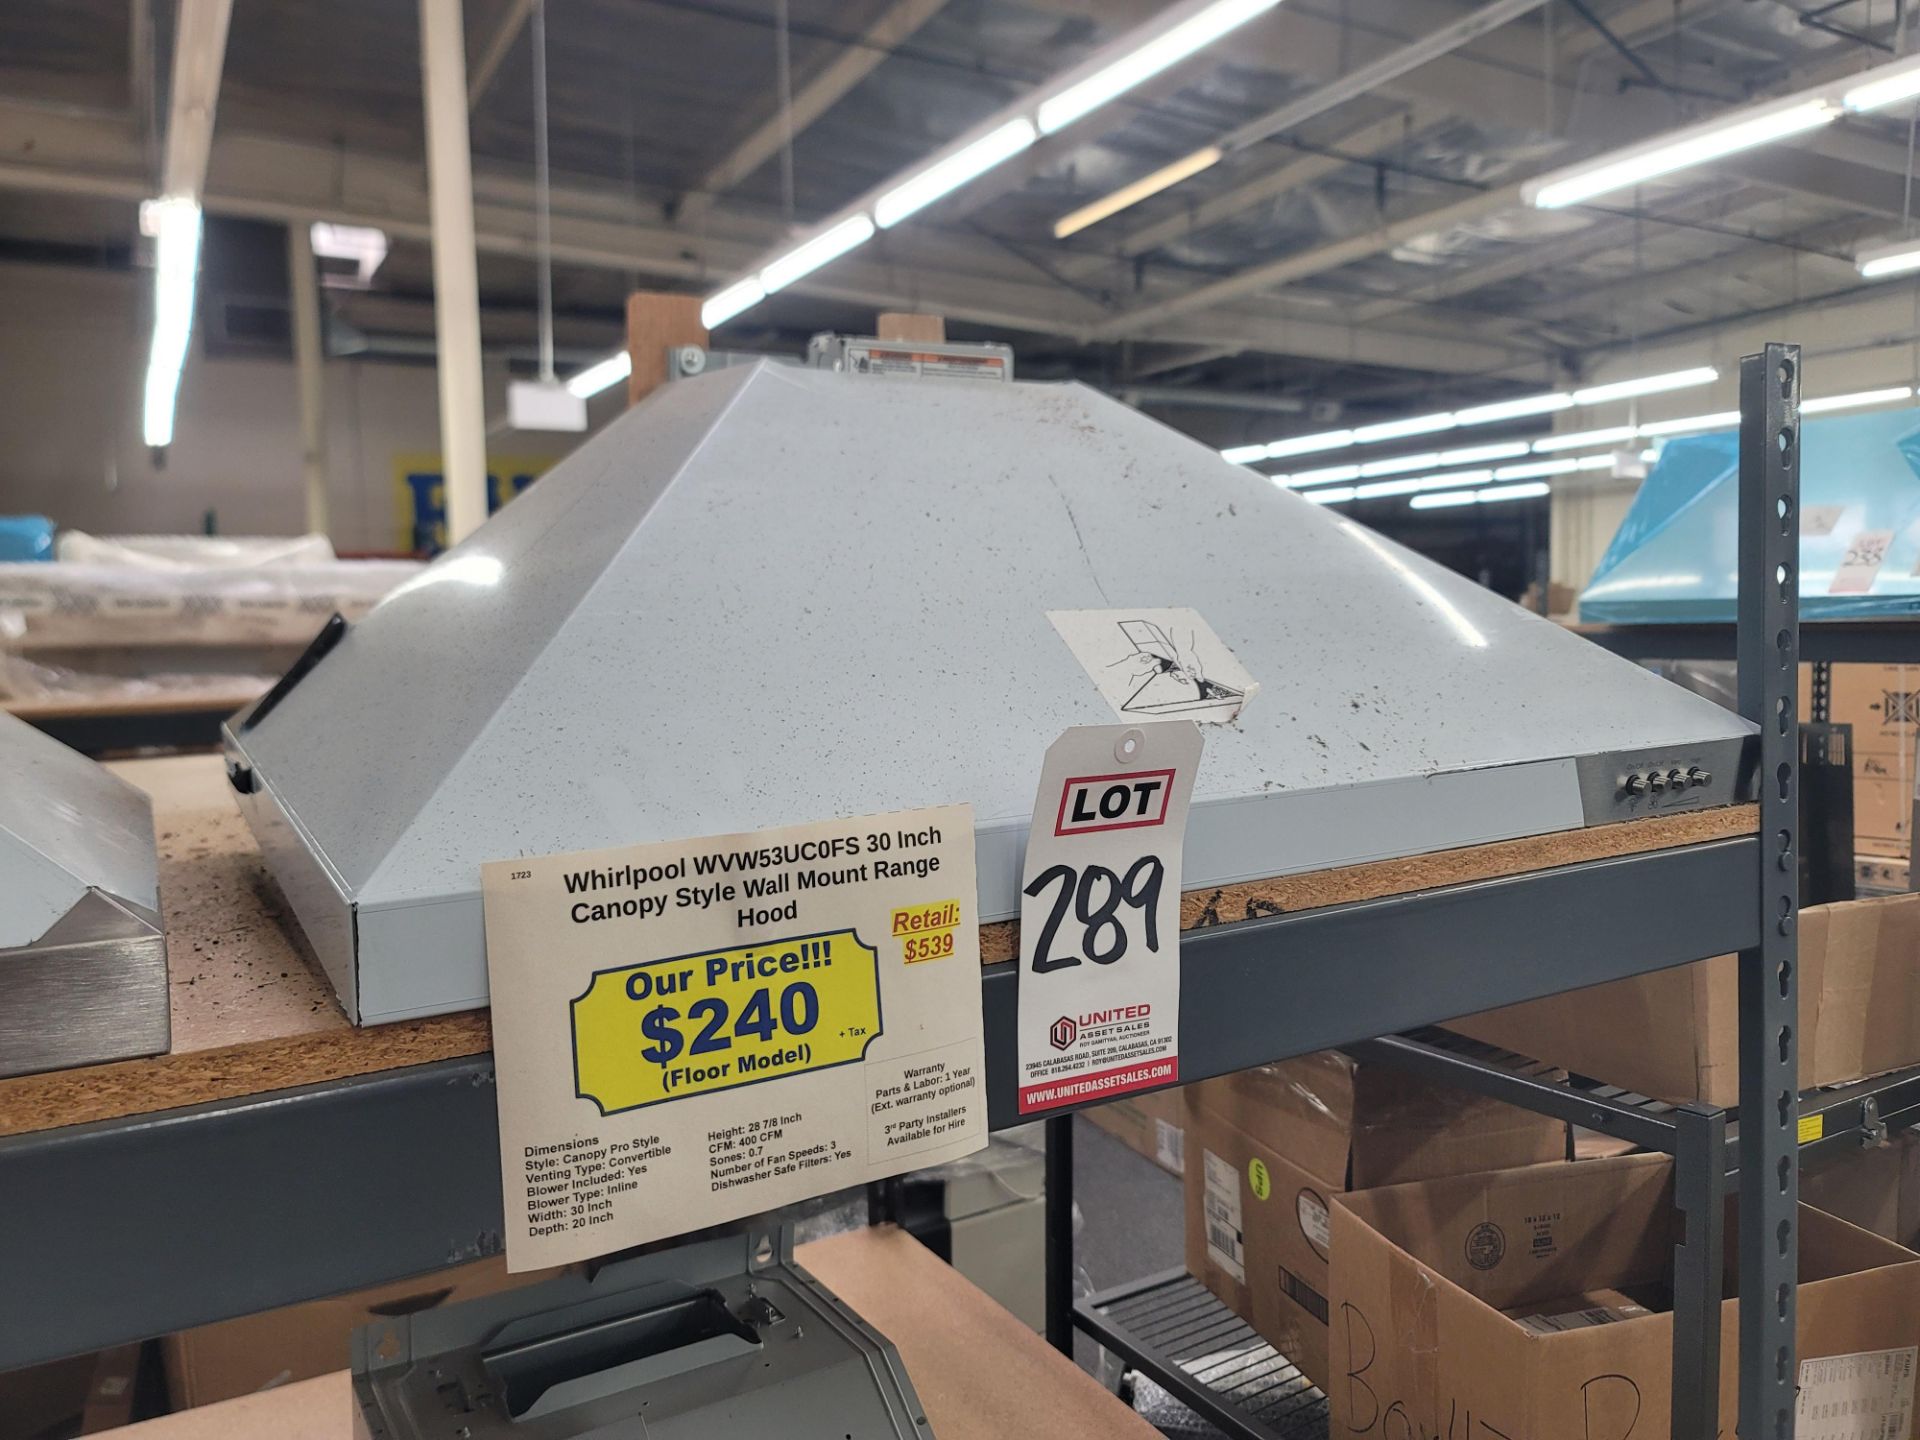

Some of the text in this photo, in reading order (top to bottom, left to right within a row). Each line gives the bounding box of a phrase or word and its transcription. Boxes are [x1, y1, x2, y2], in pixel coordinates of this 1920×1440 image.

[1071, 781, 1161, 822] LOT
[563, 826, 942, 893] Whirlpool WVW53UC0FS 30 Inch
[511, 871, 531, 880] 1723
[571, 857, 940, 923] Canopy Style Wall Mount Range
[738, 900, 797, 927] Hood
[892, 903, 960, 935] Retail:
[1024, 855, 1164, 974] 289
[904, 932, 953, 963] $539
[626, 940, 832, 1001] Our Price!!!
[641, 981, 819, 1069] $240
[1079, 1022, 1150, 1040] ASSET SALES
[1080, 1004, 1150, 1027] UNITED
[848, 1026, 866, 1037] Tax
[662, 1043, 811, 1093] (Floor Model)
[1043, 1055, 1074, 1067] CALABASAS
[1150, 1038, 1157, 1046] CA
[875, 1067, 971, 1099] Parts & Labor: 1 Year
[904, 1062, 946, 1079] Warranty
[1026, 1064, 1172, 1105] WWW.UNITEDASSETSALES.COM
[1030, 1069, 1049, 1079] OFFICE
[871, 1076, 976, 1115] (Ext. warranty optional)
[708, 1112, 802, 1142] Height: 28 7/8 Inch
[884, 1105, 967, 1134] 3rd Party Installers
[887, 1118, 966, 1147] Available for Hire
[525, 1136, 600, 1158] Dimensions
[525, 1135, 660, 1172] Style: Canopy Pro Style
[708, 1129, 783, 1154] CFM: 400 CFM
[709, 1146, 763, 1167] Sones: 0.7
[525, 1145, 672, 1184] Venting Type: Convertible
[710, 1140, 837, 1180] Number of Fan Speeds: 3
[711, 1150, 852, 1192] Dishwasher Safe Filters: Yes
[527, 1164, 648, 1198] Blower Included: Yes
[528, 1180, 638, 1211] Blower Type: Inline
[528, 1199, 613, 1224] Width: 30 Inch
[529, 1211, 614, 1237] Depth: 20 Inch
